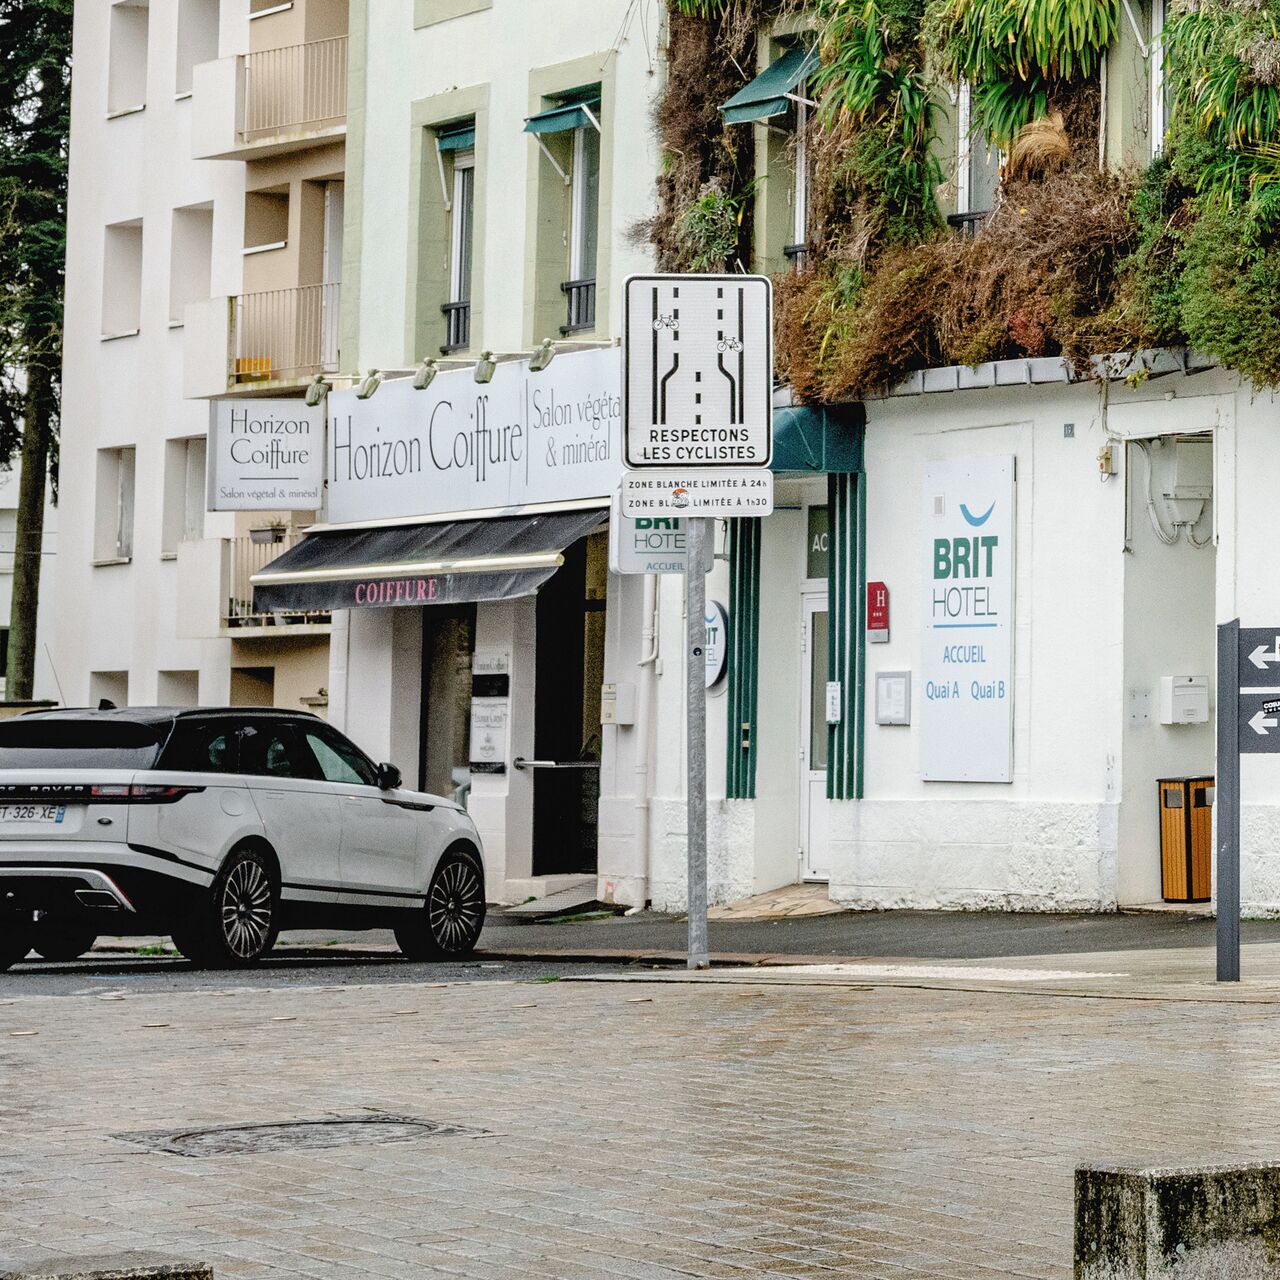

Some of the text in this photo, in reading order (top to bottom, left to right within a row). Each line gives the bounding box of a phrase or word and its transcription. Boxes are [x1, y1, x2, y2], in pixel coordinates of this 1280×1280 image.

[533, 388, 622, 430] Salon végéta
[230, 409, 310, 434] Horizon
[333, 395, 523, 482] Horizon Coiffure
[545, 420, 611, 468] & minéral
[650, 429, 749, 442] RESPECTONS
[230, 438, 309, 470] Coiffure
[643, 446, 755, 460] LES CYCLISTES
[629, 481, 653, 489] ZONE
[656, 480, 698, 489] BLANCHE
[701, 478, 738, 489] LIMITÉE
[741, 478, 747, 488] À
[220, 486, 318, 501] Salon végétal & minéral
[629, 499, 654, 508] ZONE
[693, 497, 732, 507] LIMITÉE
[736, 497, 742, 506] À
[746, 498, 767, 507] 1h30
[635, 517, 679, 530] BRI
[635, 533, 686, 549] HOTE
[812, 533, 828, 552] AC
[933, 535, 998, 579] BRIT
[646, 561, 685, 572] ACCUEIL
[355, 578, 438, 604] COIFFURE
[876, 590, 885, 607] H
[933, 586, 998, 617] HOTEL
[943, 645, 986, 663] ACCUEIL
[926, 681, 950, 700] Quai
[952, 681, 960, 699] A
[971, 681, 996, 700] Quai
[998, 680, 1005, 699] B
[0, 806, 56, 819] T-326-XE
